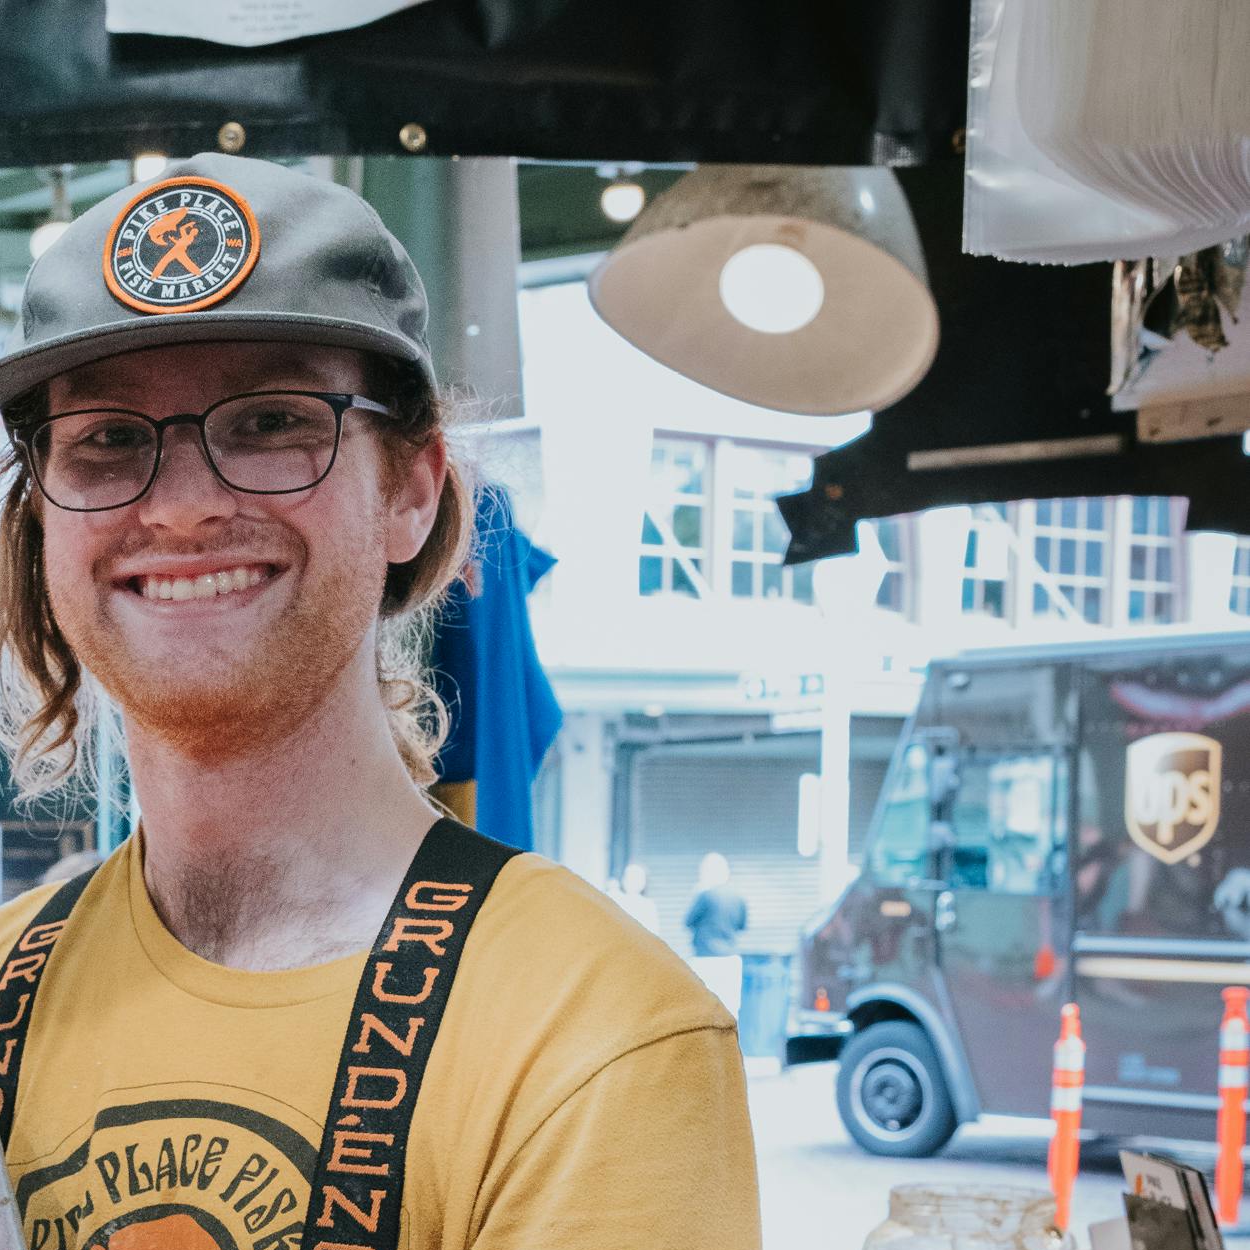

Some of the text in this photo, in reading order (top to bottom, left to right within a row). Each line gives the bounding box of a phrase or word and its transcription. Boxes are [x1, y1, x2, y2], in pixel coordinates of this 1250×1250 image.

[122, 193, 240, 241] PIKE PLACE
[226, 238, 243, 248] WA
[119, 253, 237, 298] FISH MARKET
[1134, 769, 1211, 845] ups
[95, 1133, 230, 1204] PLACE
